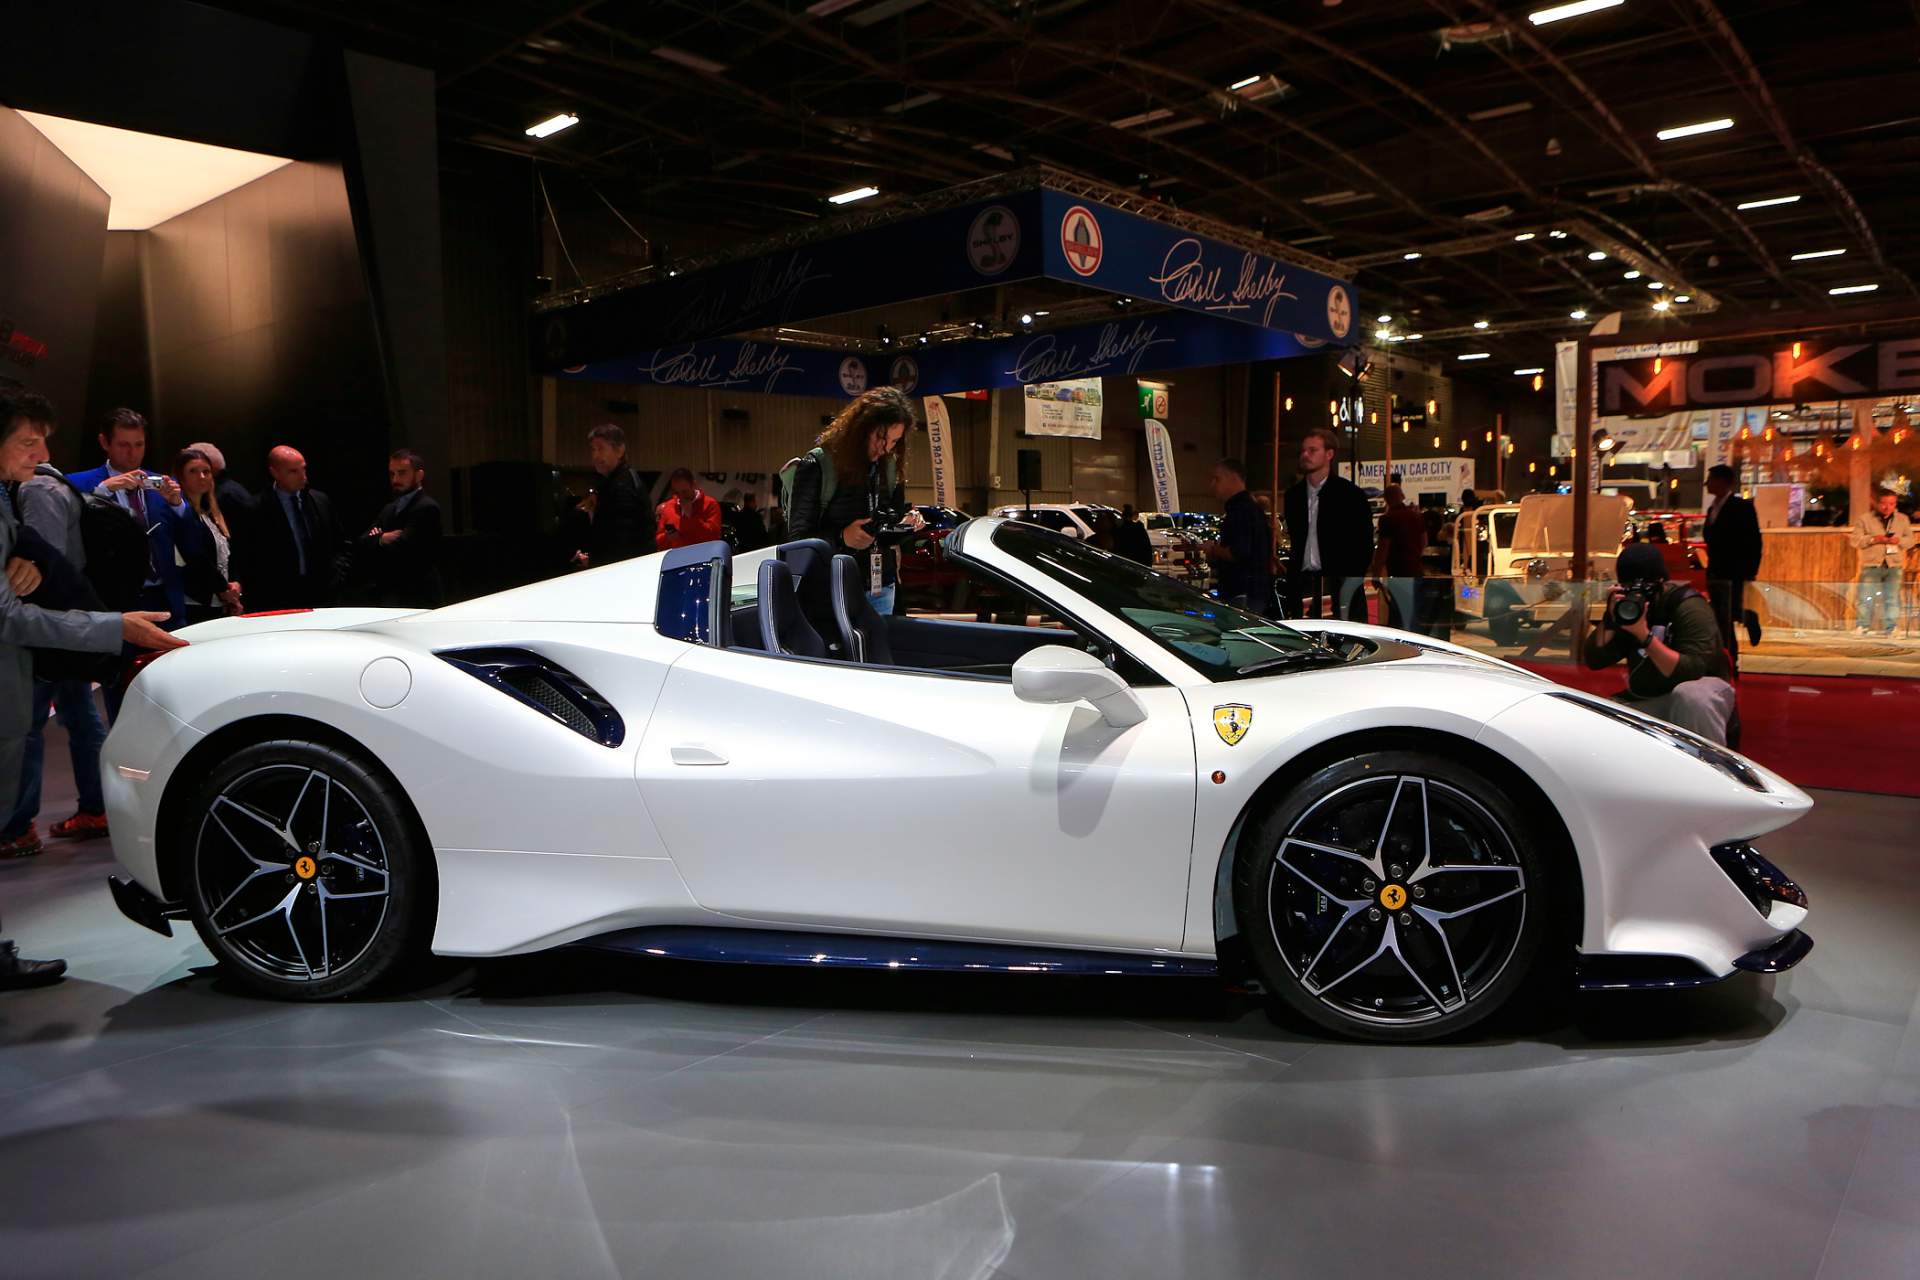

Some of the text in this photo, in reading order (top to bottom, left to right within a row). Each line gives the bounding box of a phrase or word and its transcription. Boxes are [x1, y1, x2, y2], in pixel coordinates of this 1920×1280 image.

[1232, 252, 1298, 328] Shelby
[729, 341, 805, 394] Shelby
[1089, 318, 1177, 376] Shelby
[1719, 411, 1732, 428] CIT
[1409, 462, 1428, 476] CAR
[1430, 461, 1452, 475] CITY
